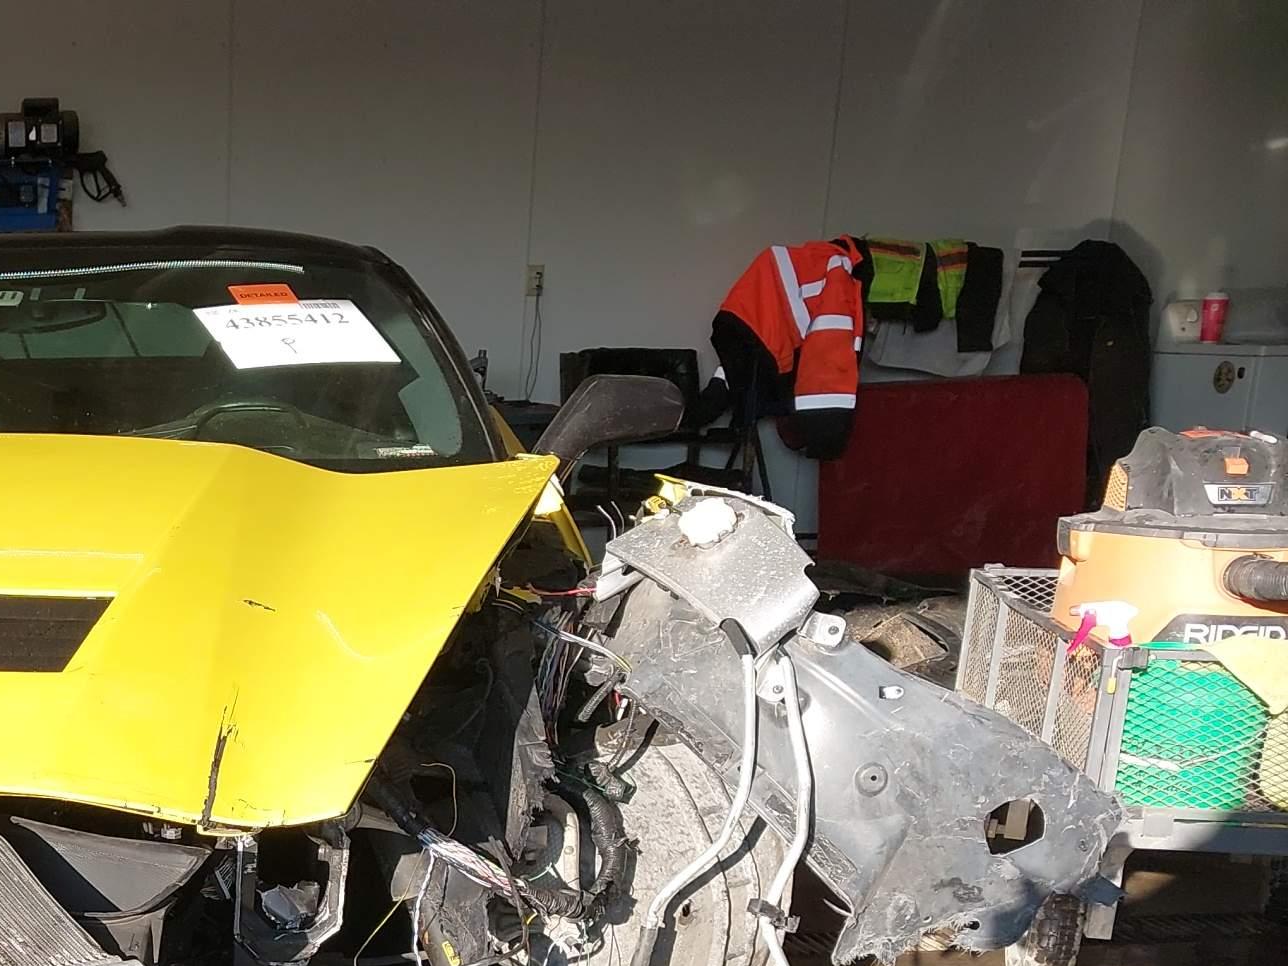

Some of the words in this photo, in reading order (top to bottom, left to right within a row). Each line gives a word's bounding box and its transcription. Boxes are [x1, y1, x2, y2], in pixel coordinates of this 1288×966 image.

[239, 291, 289, 299] DETAILED
[225, 312, 350, 330] 43855412
[1218, 487, 1259, 501] NXT
